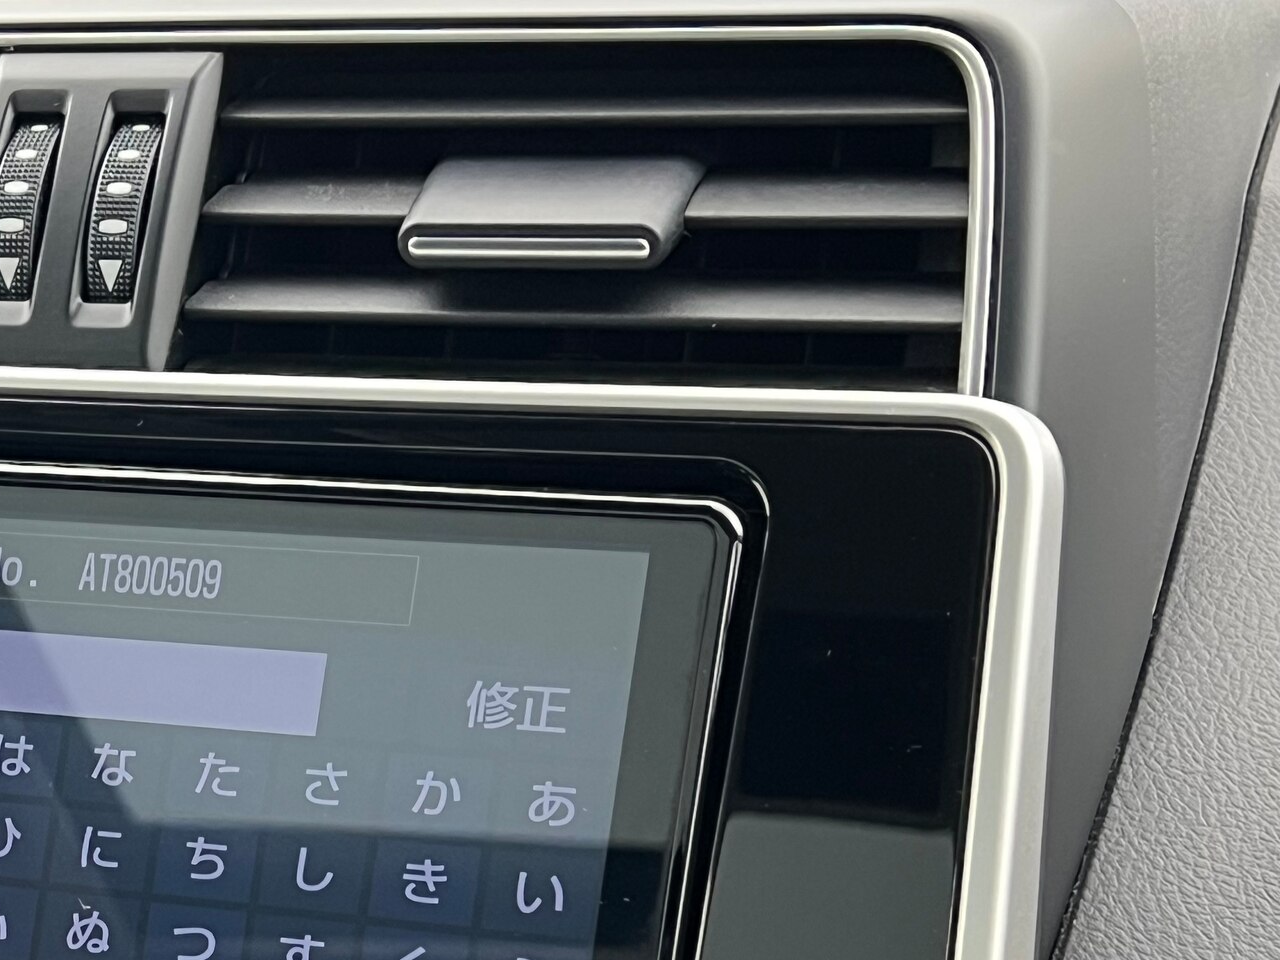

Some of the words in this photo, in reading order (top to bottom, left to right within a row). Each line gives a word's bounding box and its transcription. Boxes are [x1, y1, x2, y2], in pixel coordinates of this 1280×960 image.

[79, 552, 222, 599] AT800509
[466, 681, 571, 733] 修正
[90, 742, 137, 787] な
[195, 752, 240, 798] た
[305, 763, 348, 806] さ
[411, 771, 461, 816] か
[527, 781, 578, 827] あ
[80, 826, 122, 868] に
[186, 837, 228, 880] ち
[295, 846, 334, 892] し
[403, 859, 448, 905] き
[515, 871, 564, 914] い
[66, 911, 110, 954] ぬ
